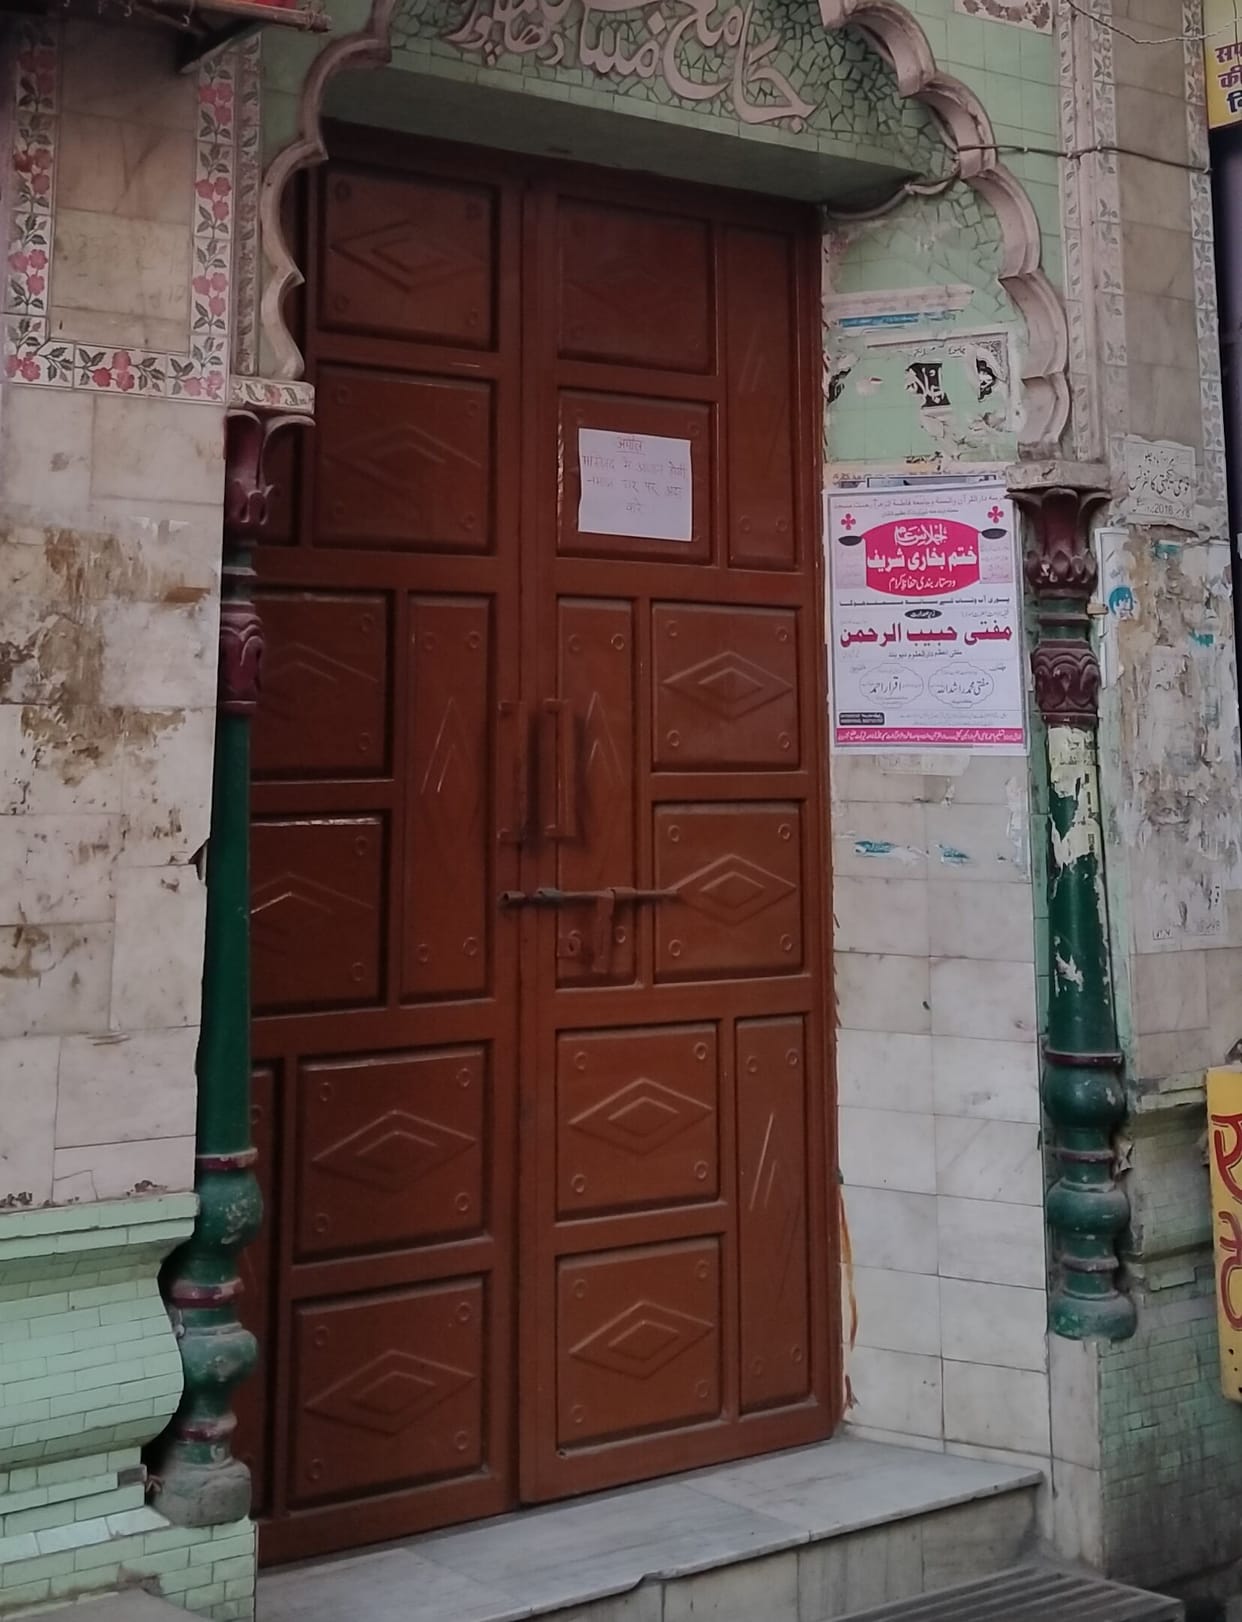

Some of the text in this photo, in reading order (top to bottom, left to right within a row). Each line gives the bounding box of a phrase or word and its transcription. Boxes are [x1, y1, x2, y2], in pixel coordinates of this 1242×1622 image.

[867, 548, 905, 572] شریف
[907, 548, 946, 571] بخاری
[949, 545, 978, 572] ختم
[840, 619, 1012, 648] مفتی حبیب الرحمن
